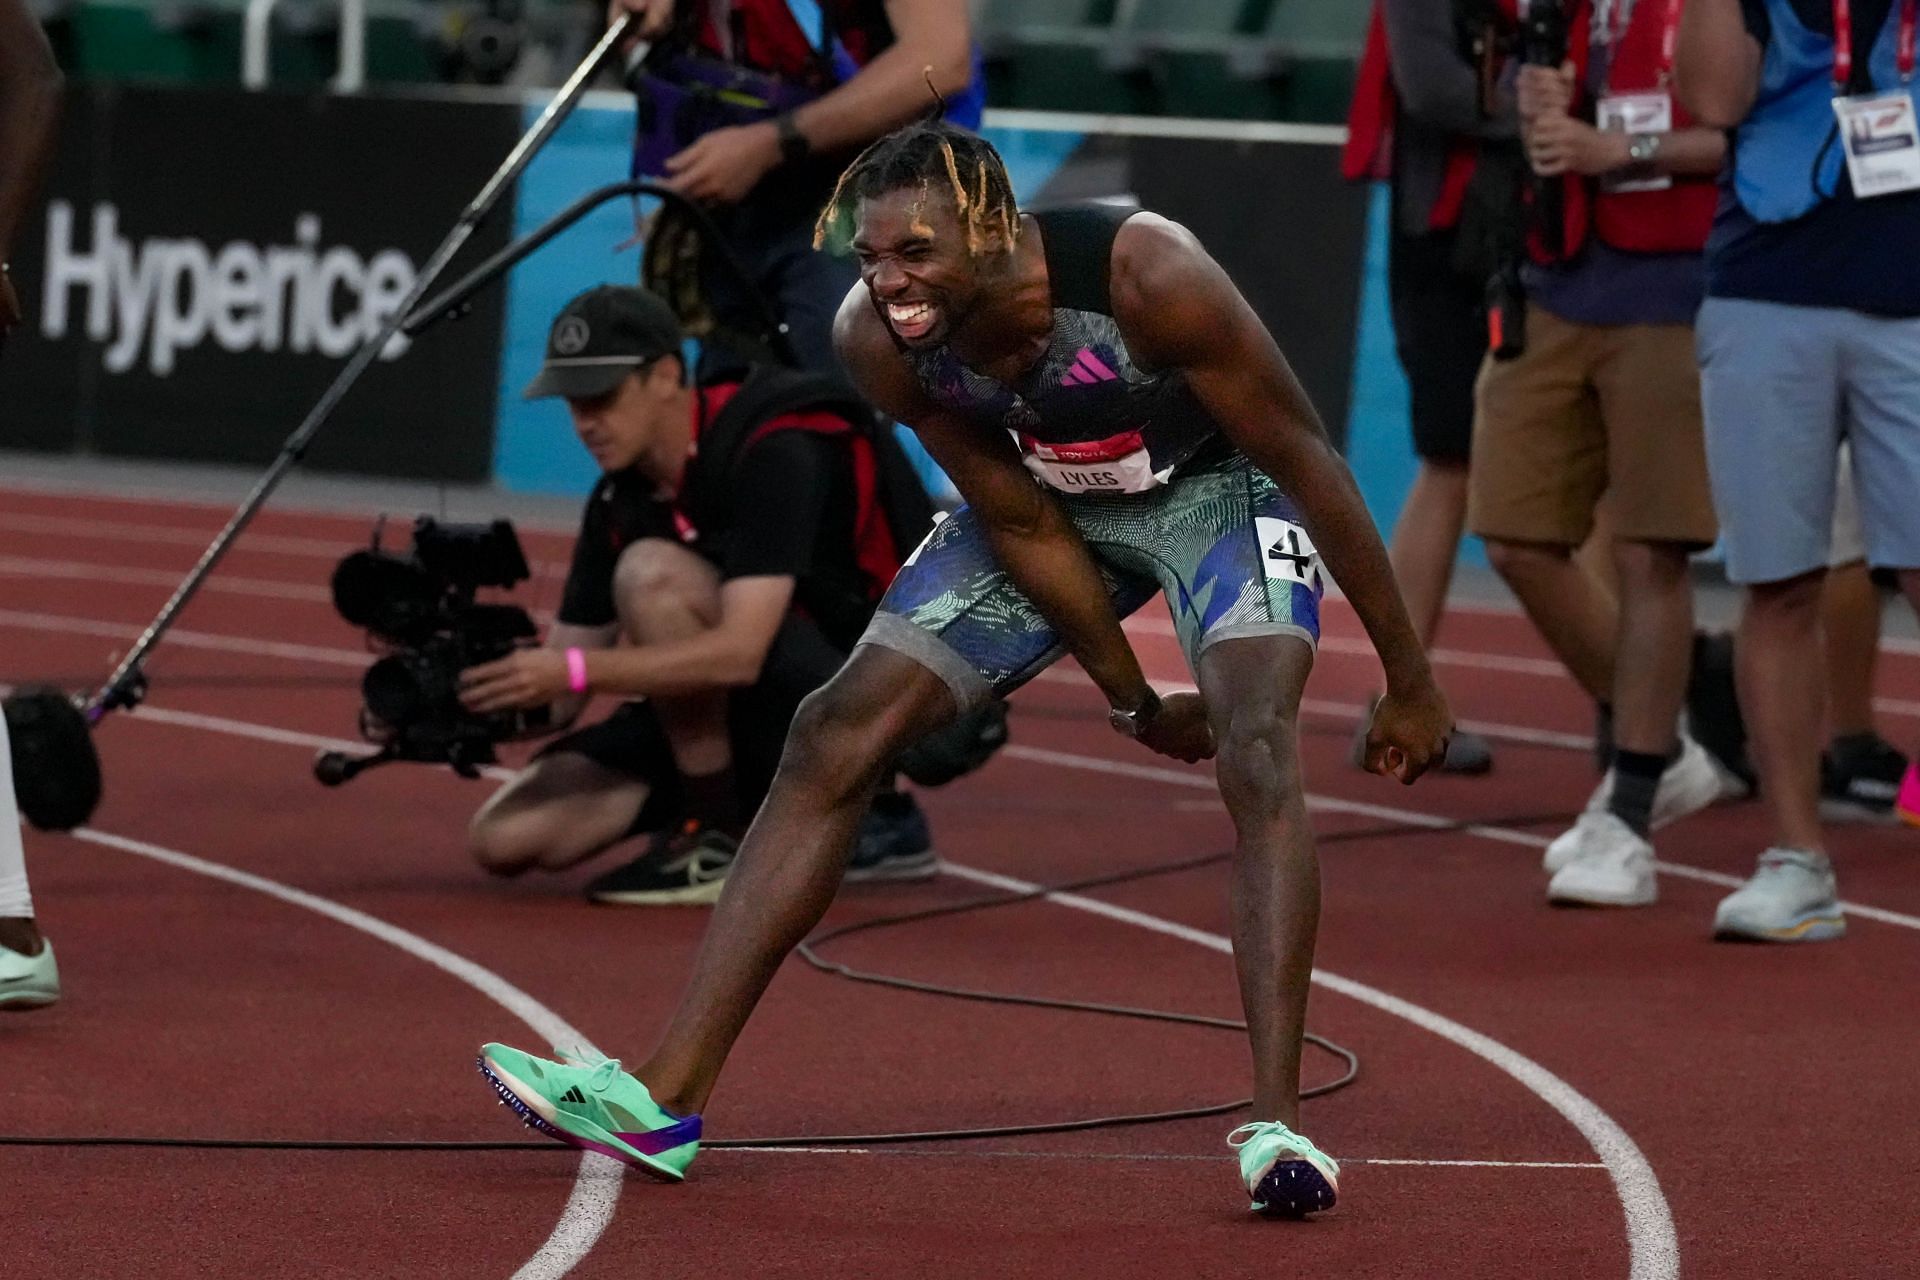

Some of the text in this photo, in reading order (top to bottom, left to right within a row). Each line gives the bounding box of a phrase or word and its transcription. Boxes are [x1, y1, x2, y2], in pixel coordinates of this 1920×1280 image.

[41, 200, 417, 377] Hyperice
[1060, 471, 1119, 486] LYLES
[1268, 529, 1310, 578] 4
